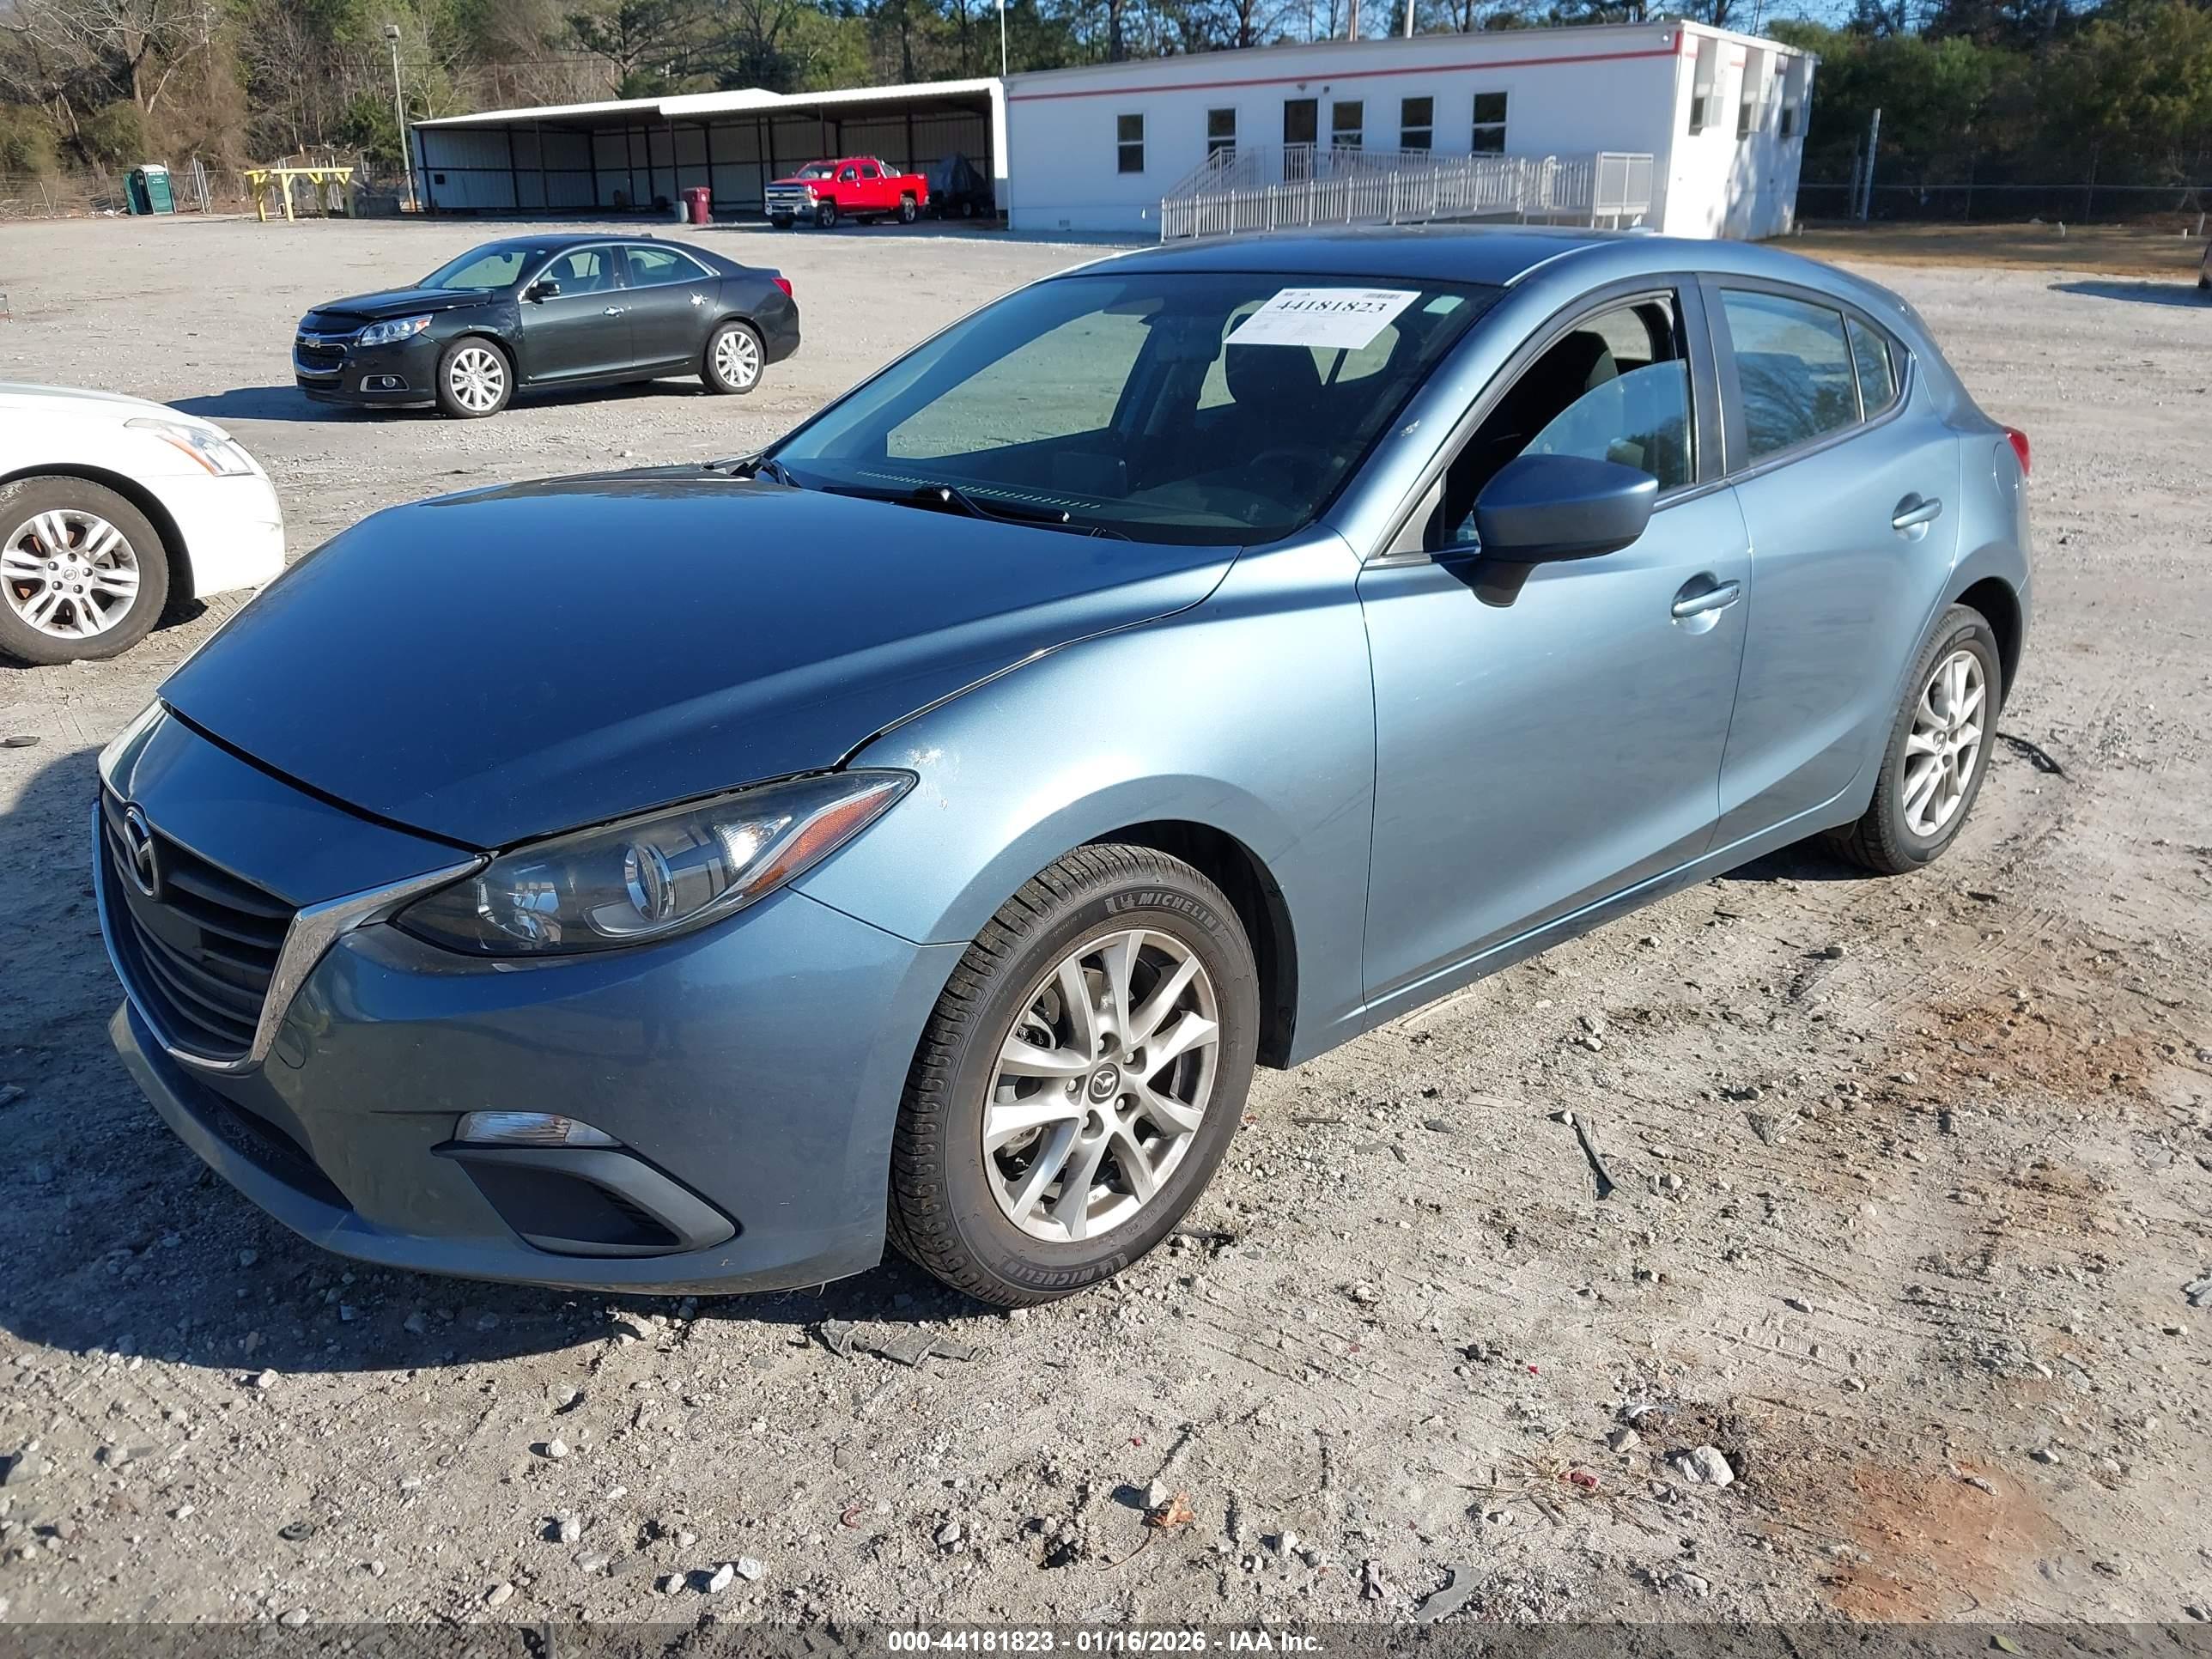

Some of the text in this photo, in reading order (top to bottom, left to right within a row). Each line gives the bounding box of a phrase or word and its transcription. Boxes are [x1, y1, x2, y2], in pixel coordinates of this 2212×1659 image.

[1276, 301, 1388, 313] 44181823
[1138, 892, 1217, 928] MICHELIN
[1004, 1262, 1096, 1285] MICHELIN
